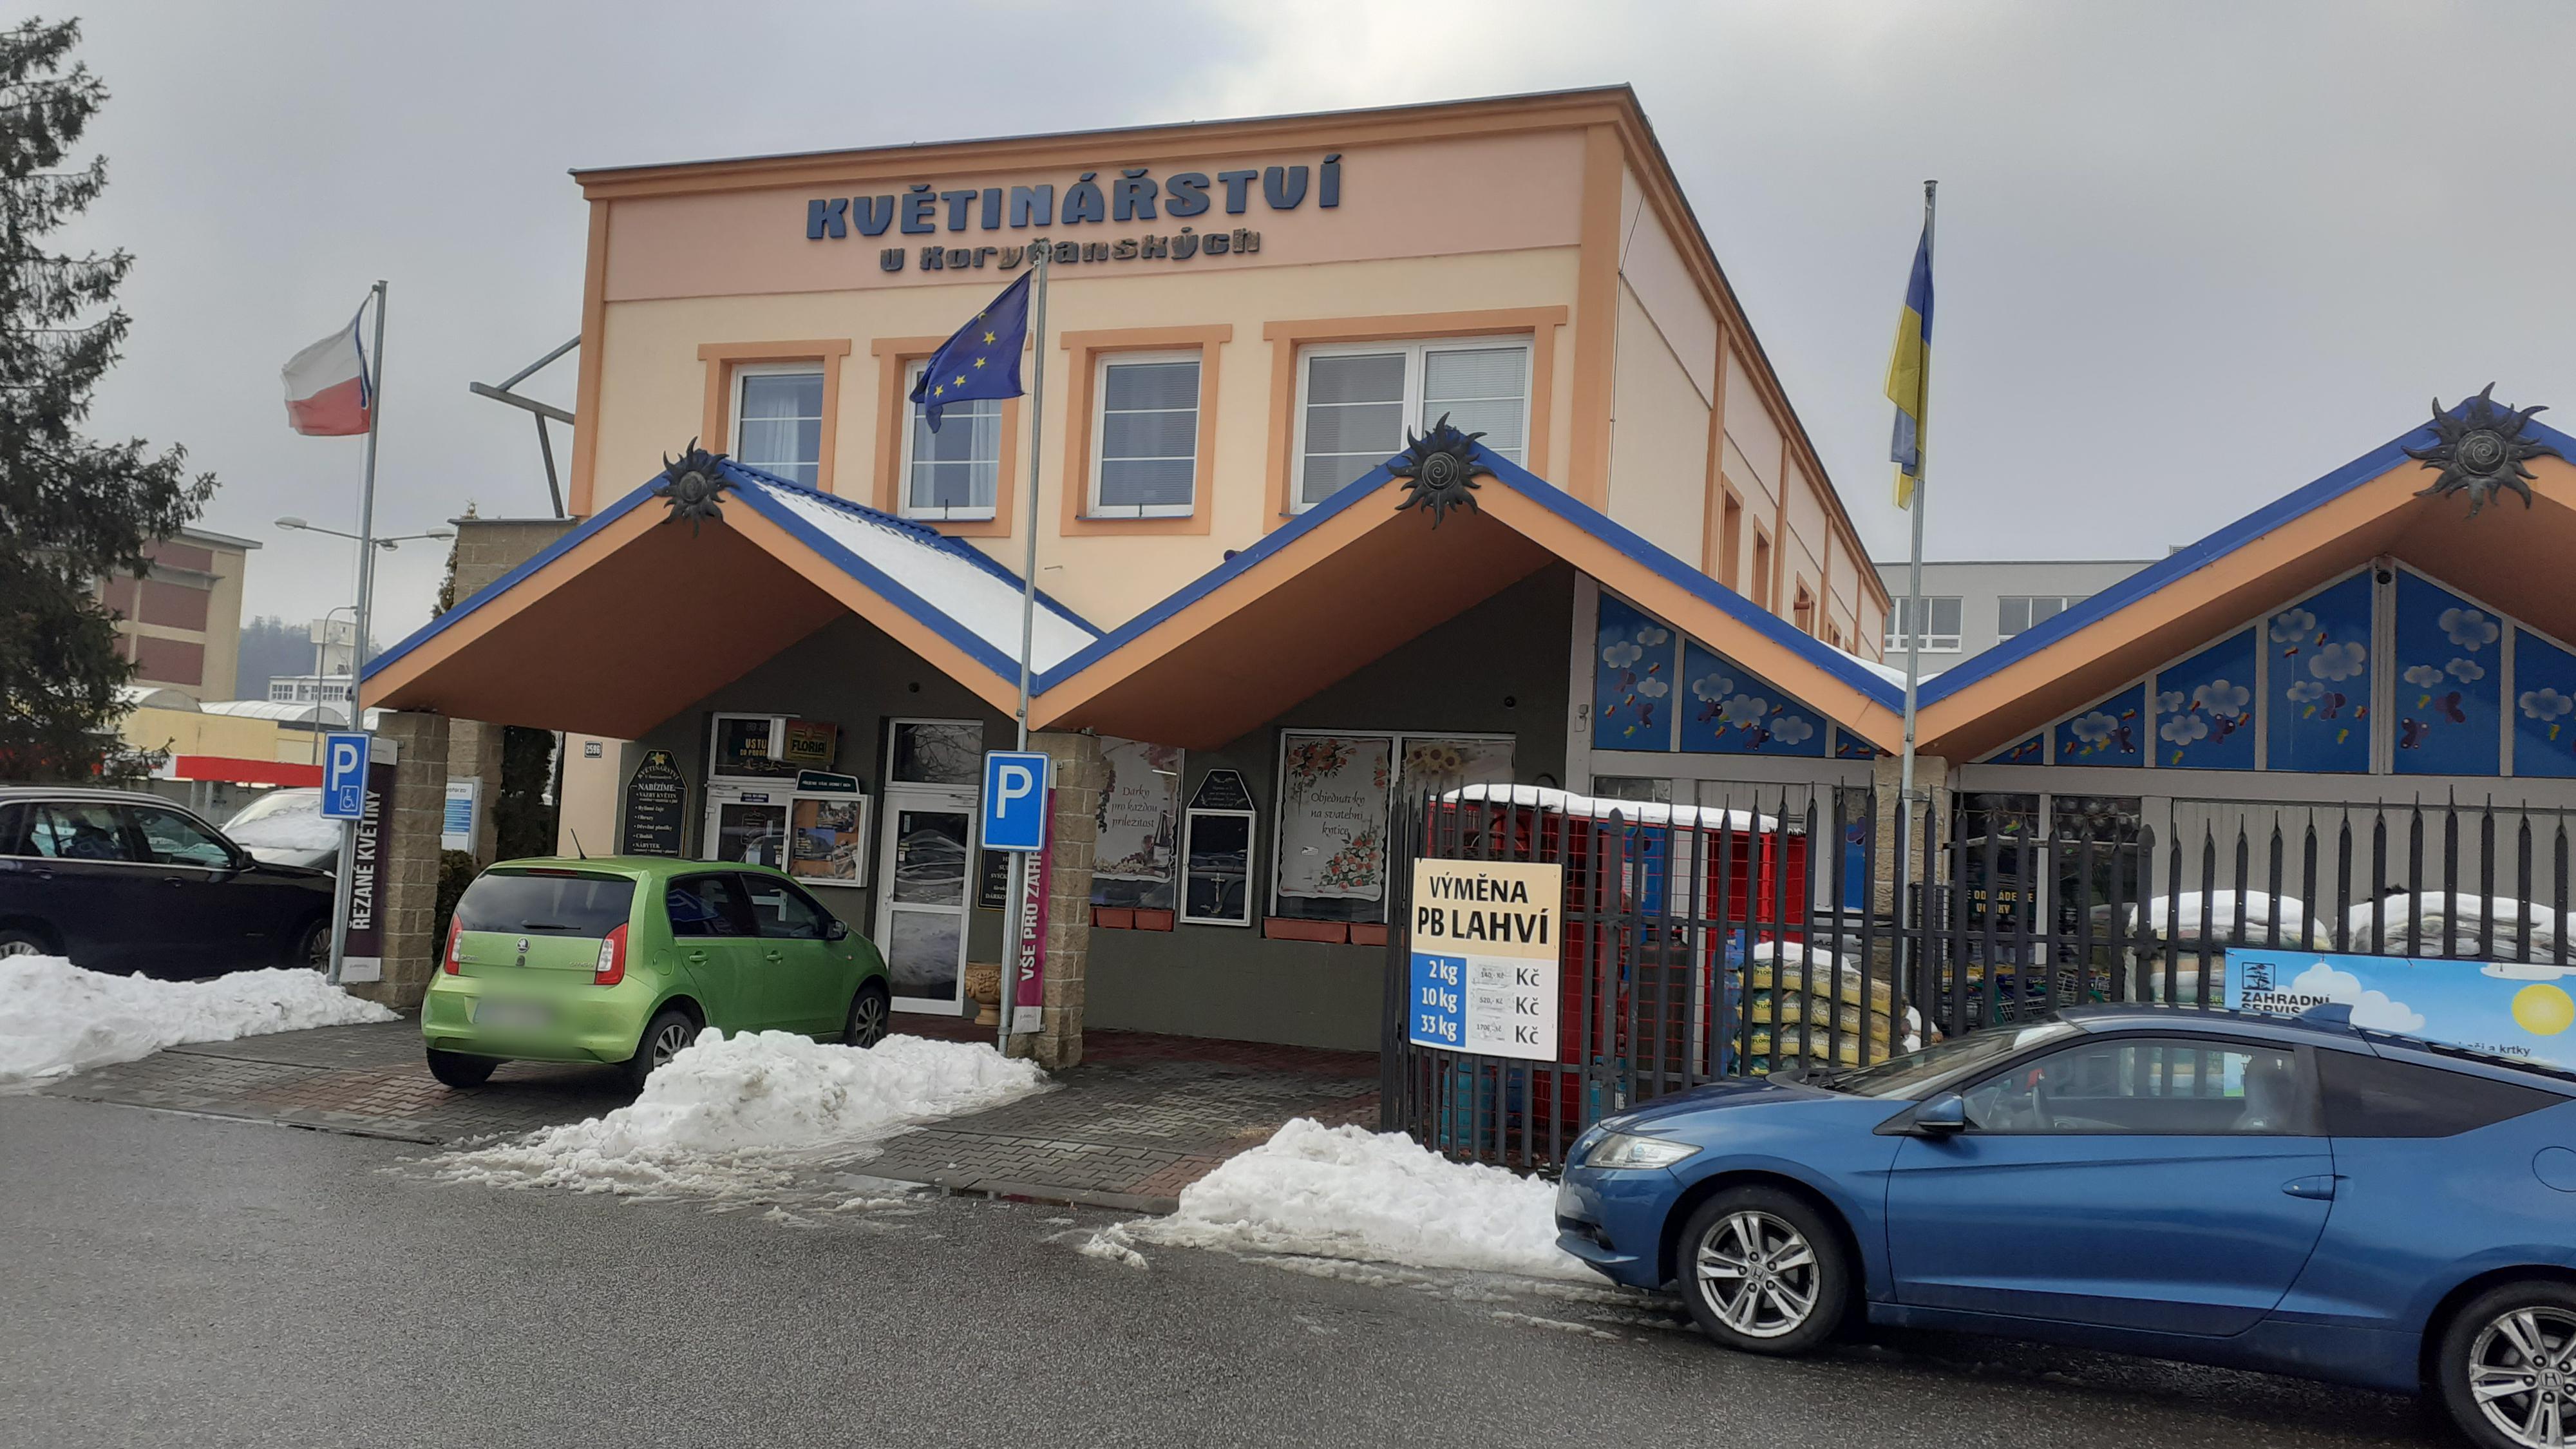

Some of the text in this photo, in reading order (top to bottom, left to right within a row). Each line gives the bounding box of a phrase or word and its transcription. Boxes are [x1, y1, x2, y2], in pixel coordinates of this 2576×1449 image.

[806, 153, 1342, 239] KVĚTINÁŘSTVÍ
[586, 744, 600, 754] 2596
[792, 739, 824, 752] FLORIA
[331, 743, 358, 791] P
[996, 764, 1033, 819] P
[1322, 822, 1349, 837] kytice
[348, 790, 381, 930] ŘEZANÉ KVĚTINY
[1430, 871, 1529, 904] VÝMĚNA
[1023, 902, 1039, 940] PRO
[1417, 906, 1549, 945] PB LAHVÍ
[1019, 944, 1035, 981] VŠE
[1429, 959, 1458, 985] 2 kg
[1516, 967, 1540, 987] Kč
[1422, 987, 1458, 1014] 10 kg
[1516, 996, 1540, 1016] Kč
[2242, 991, 2330, 1006] ZAHRADNÍ
[1421, 1014, 1457, 1042] 33 kg
[1515, 1025, 1539, 1045] Kč
[2499, 1043, 2531, 1057] krtky
